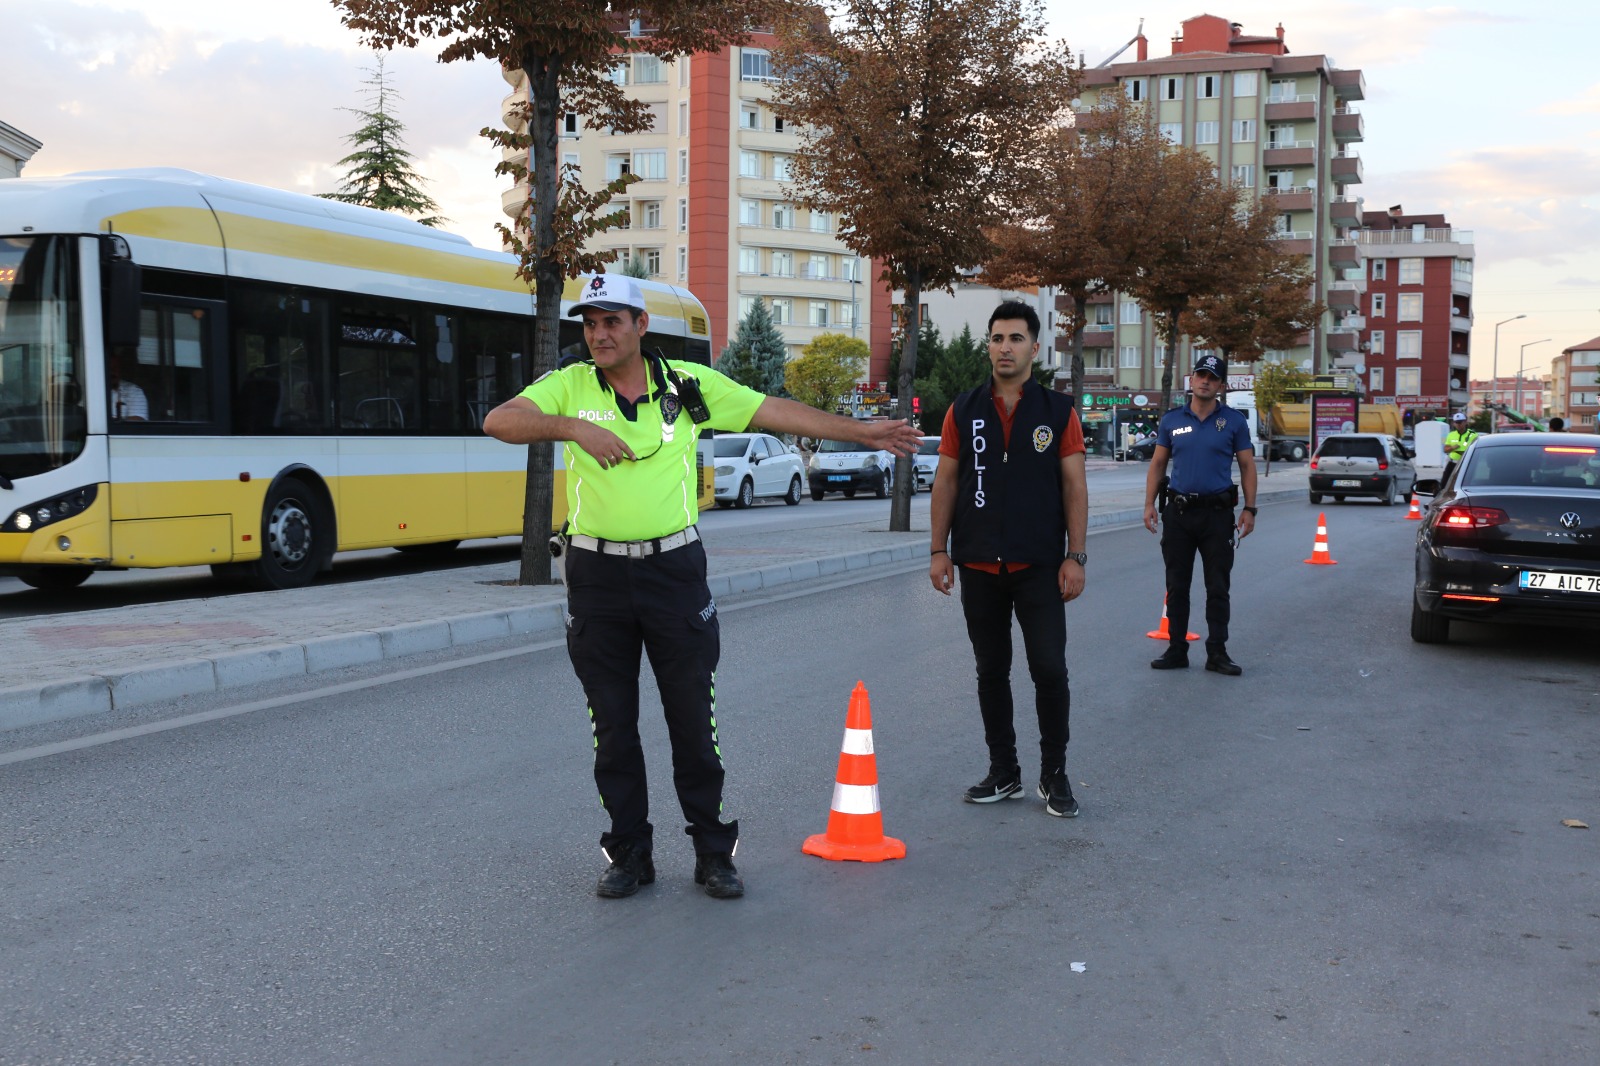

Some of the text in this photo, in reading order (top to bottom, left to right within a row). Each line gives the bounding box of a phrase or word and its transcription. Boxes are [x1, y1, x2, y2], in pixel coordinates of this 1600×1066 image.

[1096, 395, 1131, 407] Coşkun
[1546, 531, 1593, 539] PASSAT
[1529, 573, 1547, 587] 27
[1558, 575, 1583, 590] AIC
